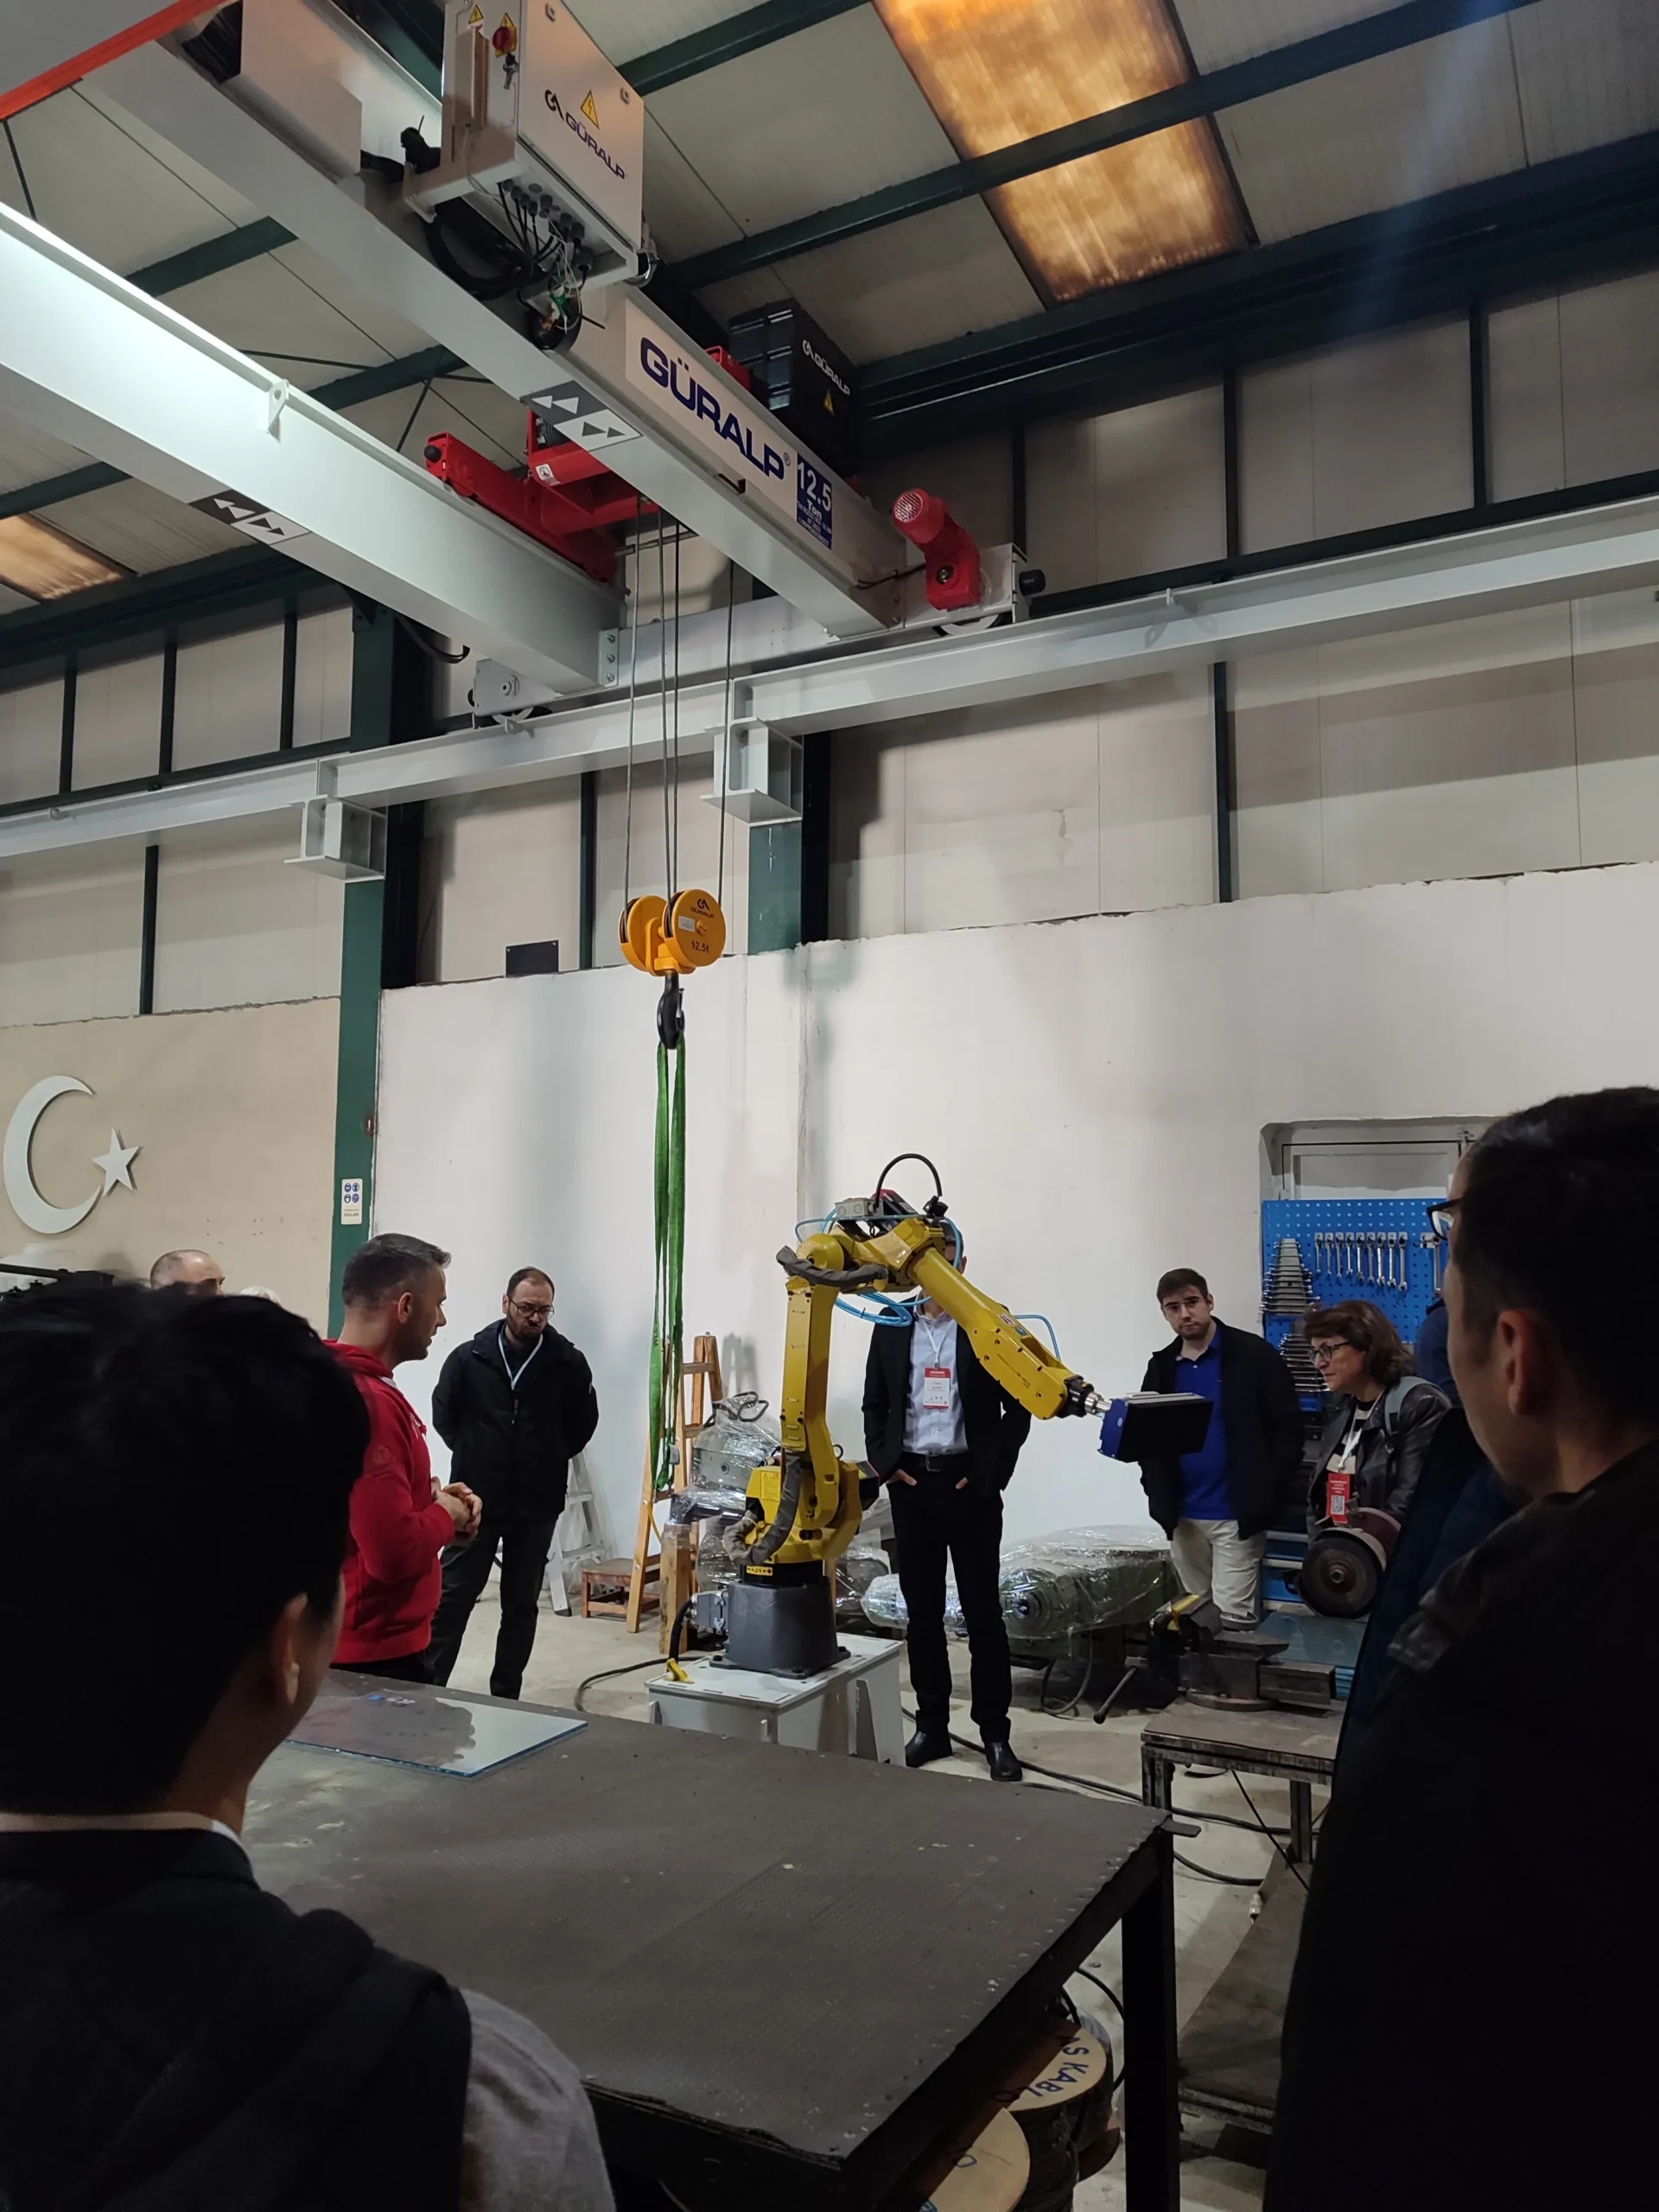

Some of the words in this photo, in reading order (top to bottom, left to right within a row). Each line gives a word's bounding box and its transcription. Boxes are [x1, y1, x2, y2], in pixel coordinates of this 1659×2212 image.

[566, 111, 625, 180] GÜRALP
[814, 353, 850, 396] GÜRALP
[640, 337, 785, 480] GÜRALP
[798, 461, 831, 512] 12.5
[806, 499, 822, 520] Ton
